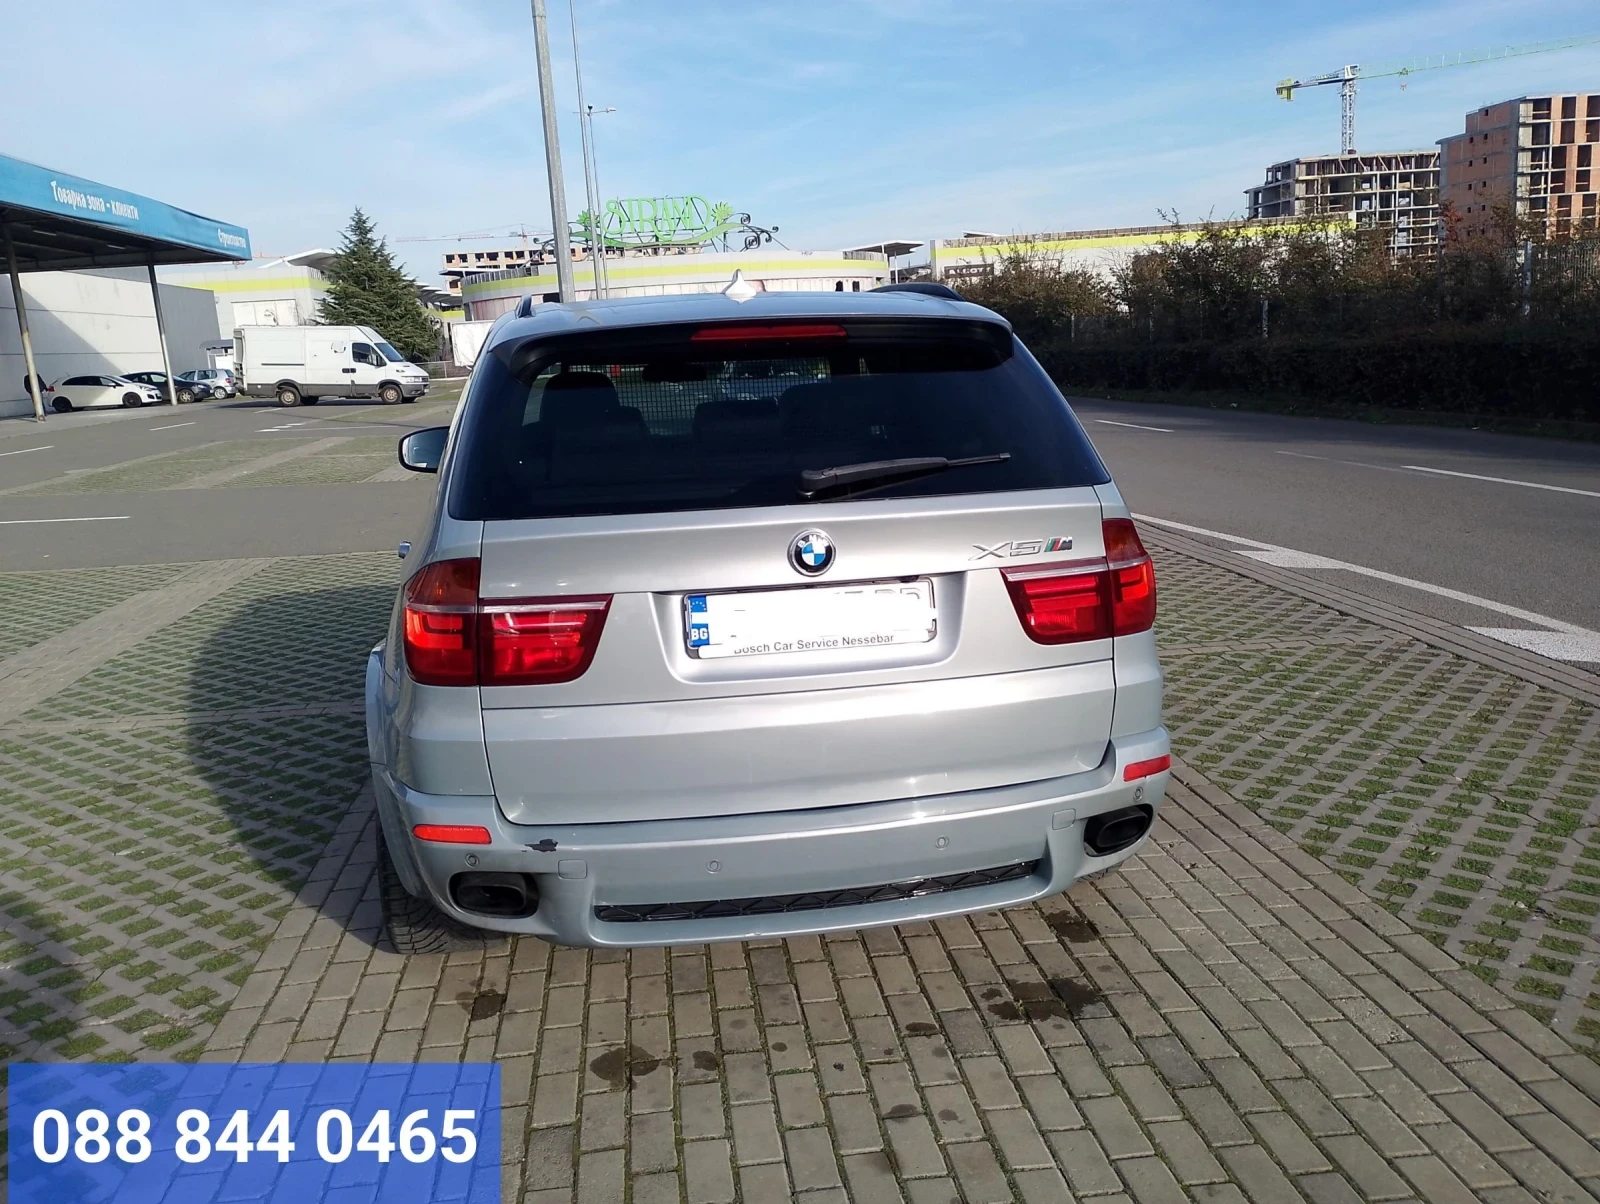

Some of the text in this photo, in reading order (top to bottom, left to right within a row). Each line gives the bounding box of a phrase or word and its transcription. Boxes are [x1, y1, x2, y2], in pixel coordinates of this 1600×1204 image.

[50, 180, 87, 210] Товарна
[86, 194, 106, 212] зона
[602, 195, 711, 242] STRAND
[797, 534, 830, 548] BMW
[968, 538, 1044, 561] X5
[690, 627, 709, 641] BG
[734, 633, 895, 655] osch Car Service Nessebar
